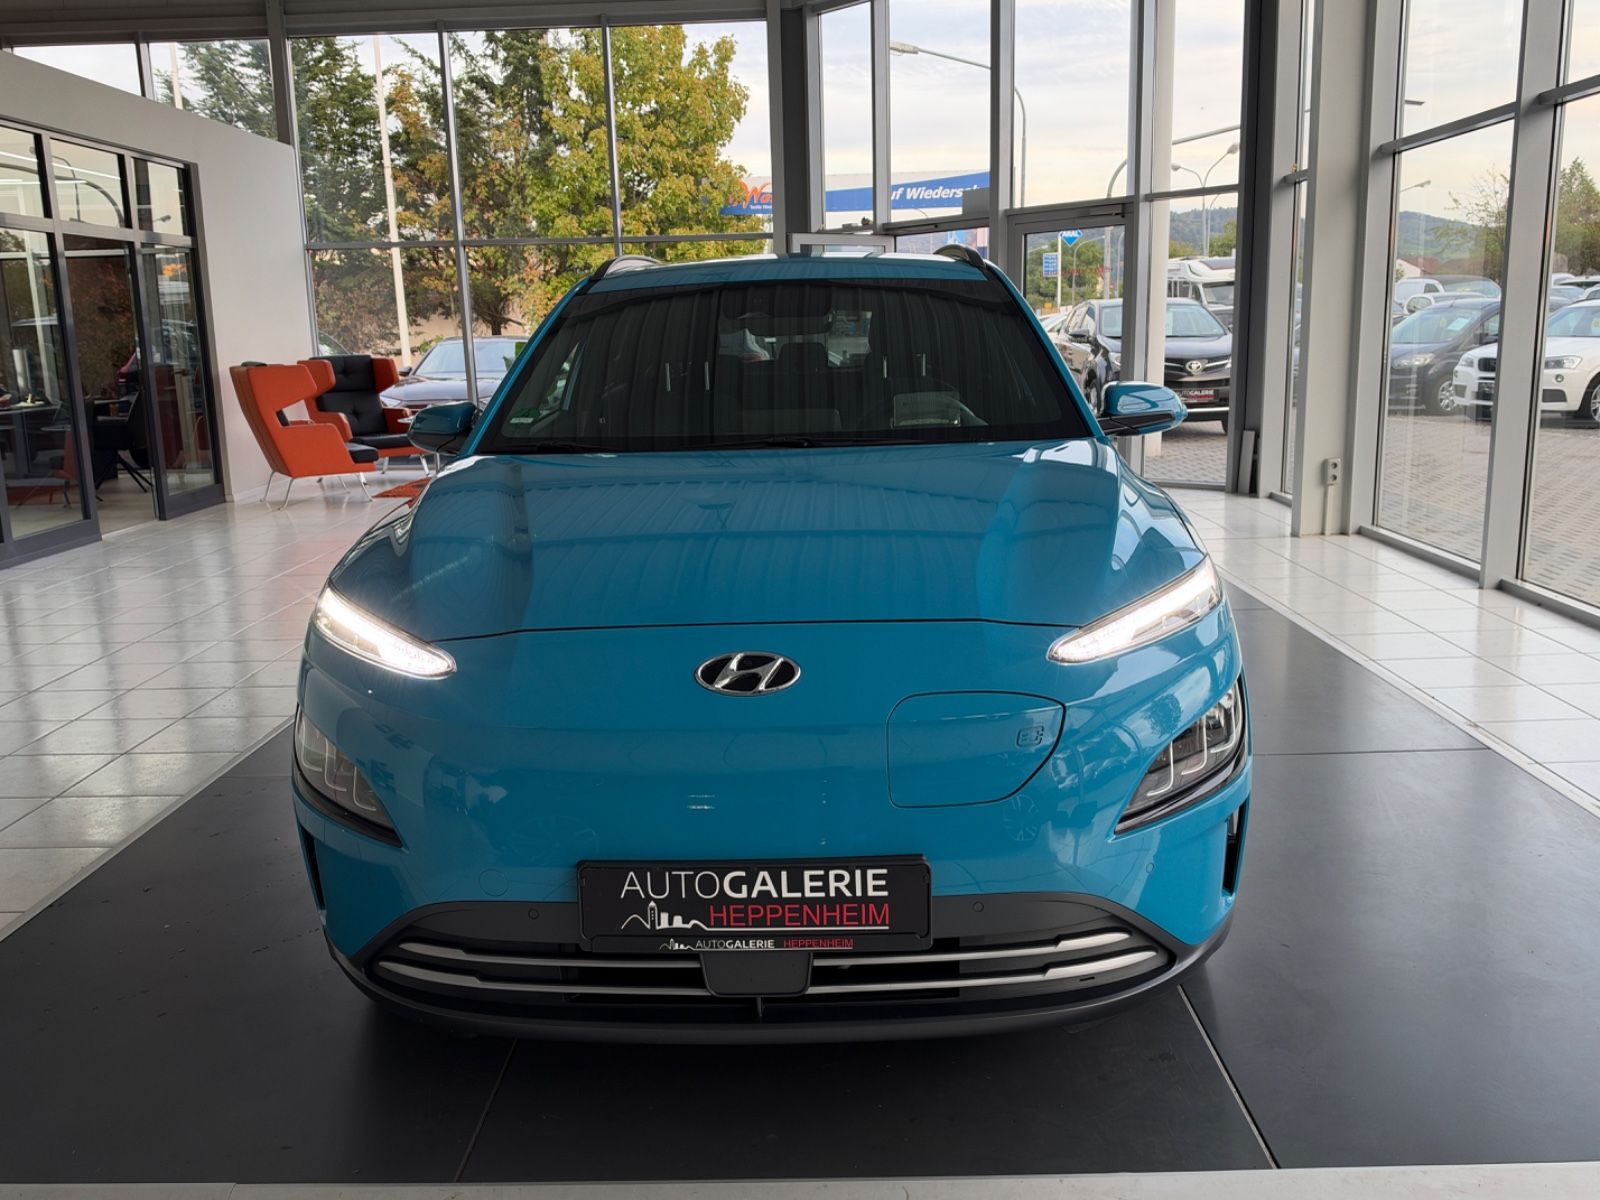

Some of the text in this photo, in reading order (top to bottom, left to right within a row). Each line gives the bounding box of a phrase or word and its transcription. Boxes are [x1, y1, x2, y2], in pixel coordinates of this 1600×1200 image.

[906, 184, 980, 200] Wieders
[620, 868, 889, 899] AUTOGALERIE
[708, 903, 890, 927] HEPPENHEIM
[695, 938, 854, 949] AUTOGALERIE HEPPENHEIM
